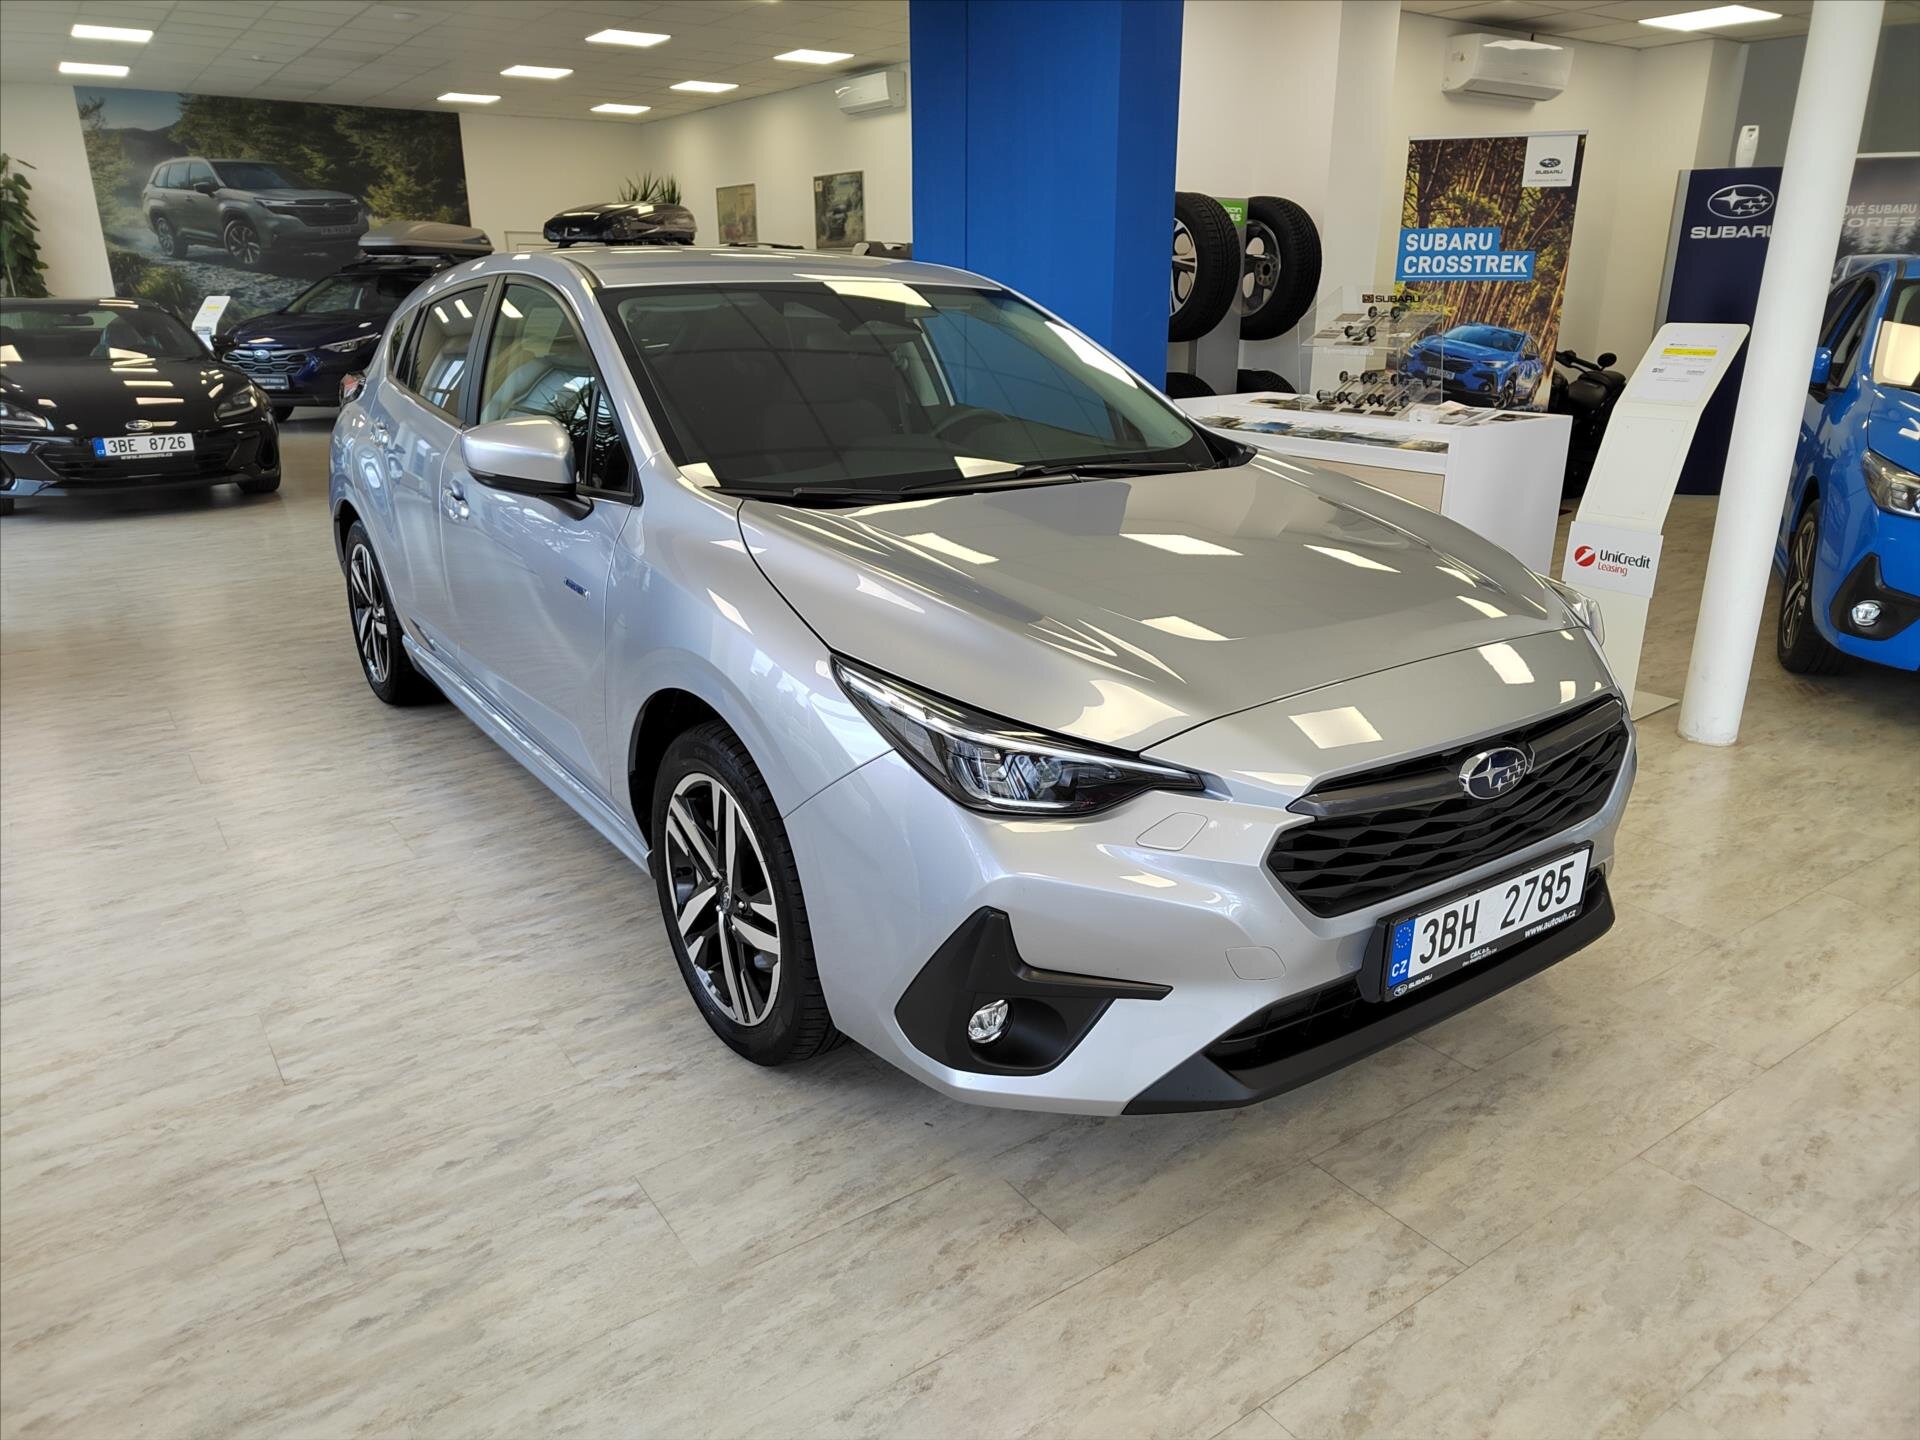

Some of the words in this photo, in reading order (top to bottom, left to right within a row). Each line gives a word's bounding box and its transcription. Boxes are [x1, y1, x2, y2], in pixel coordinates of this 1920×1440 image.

[1844, 202, 1866, 215] OVÉ
[1867, 203, 1917, 215] SUBARU
[1843, 216, 1920, 228] ORES
[1405, 232, 1493, 252] SUBARU
[1403, 254, 1529, 274] CROSSTREK
[1375, 294, 1421, 303] SUBARU
[108, 439, 137, 454] 3BE
[149, 436, 186, 451] 8726
[1600, 549, 1651, 569] UniCredit
[1597, 562, 1628, 577] Leasing
[1419, 899, 1480, 965] 3BH
[1499, 861, 1575, 930] 2785
[1391, 959, 1408, 977] CZ
[1408, 973, 1433, 989] SUBARU
